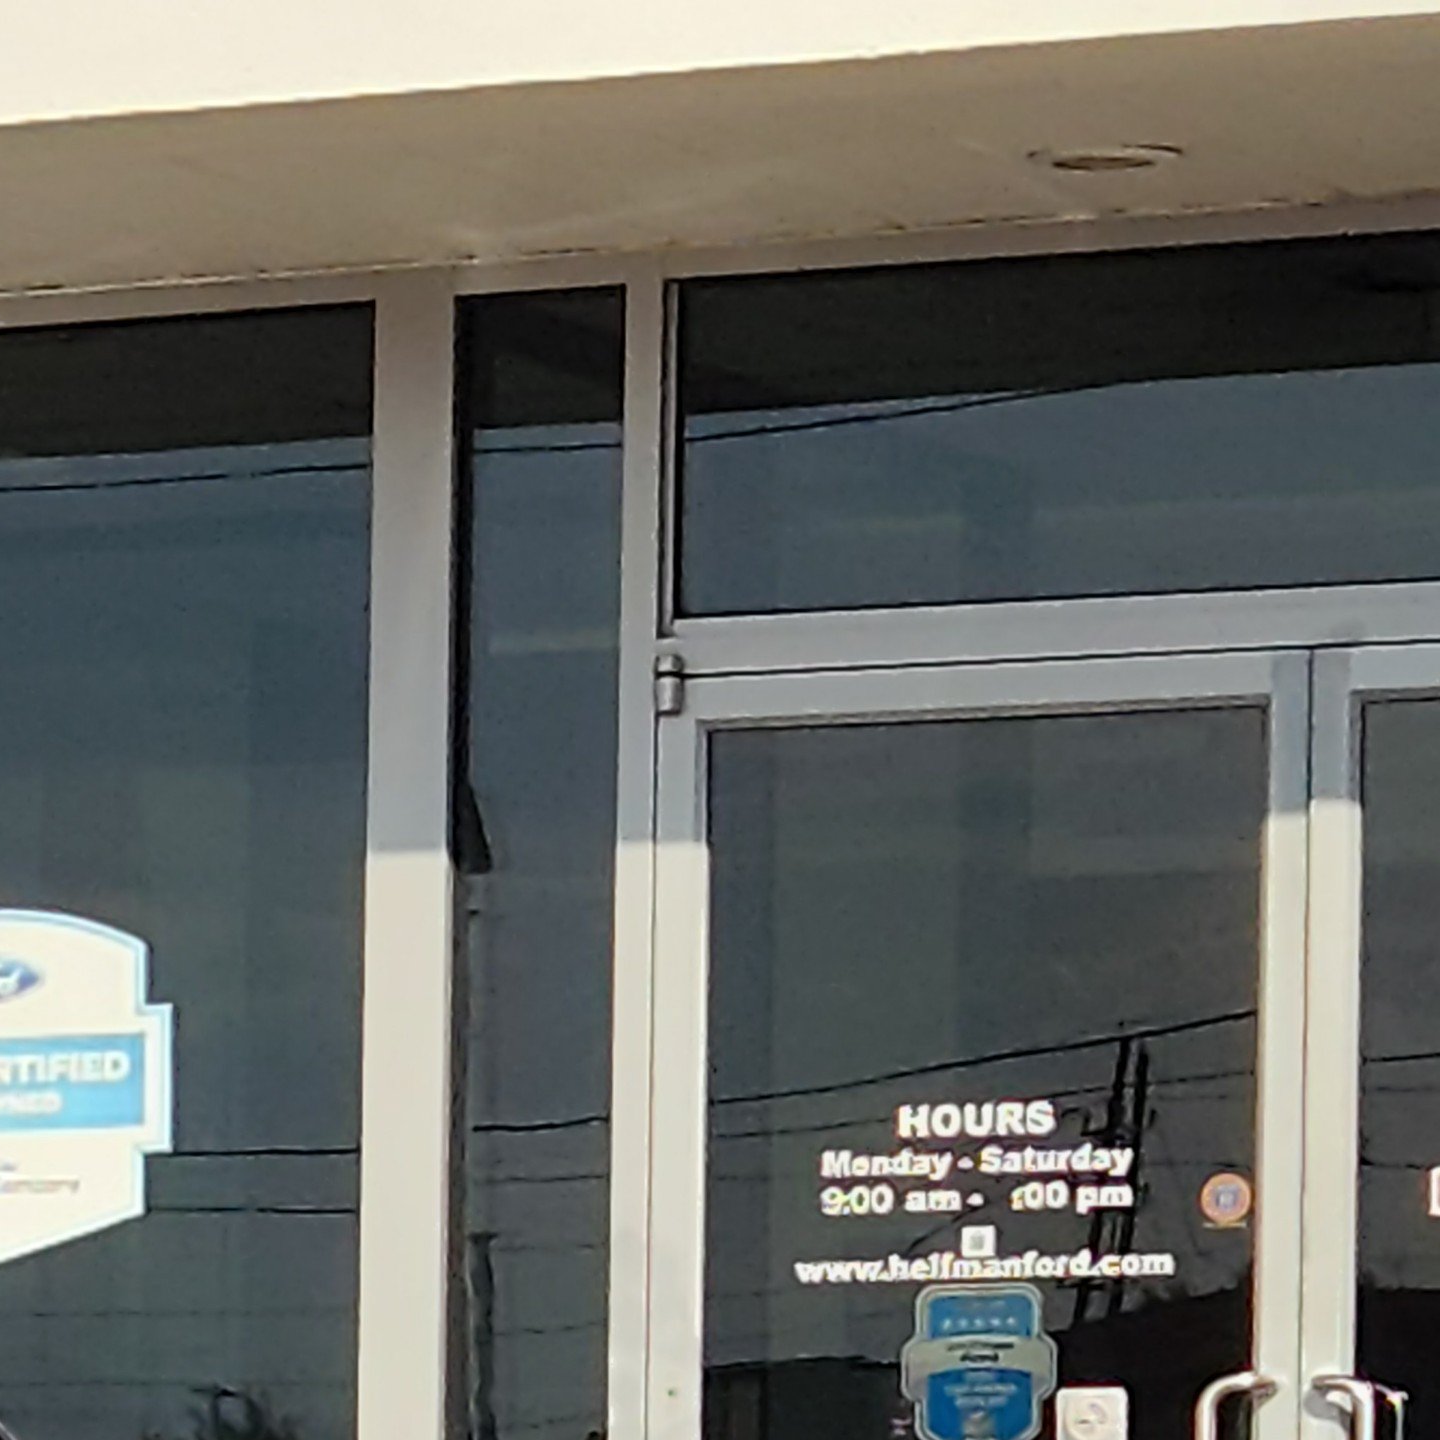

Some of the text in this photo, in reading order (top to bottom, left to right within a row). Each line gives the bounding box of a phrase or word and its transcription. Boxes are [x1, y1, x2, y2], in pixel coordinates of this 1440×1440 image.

[897, 1100, 1057, 1138] HOURS
[819, 1147, 953, 1180] Monday
[978, 1144, 1135, 1176] Saturday
[903, 1189, 963, 1212] am
[1076, 1183, 1135, 1215] pm
